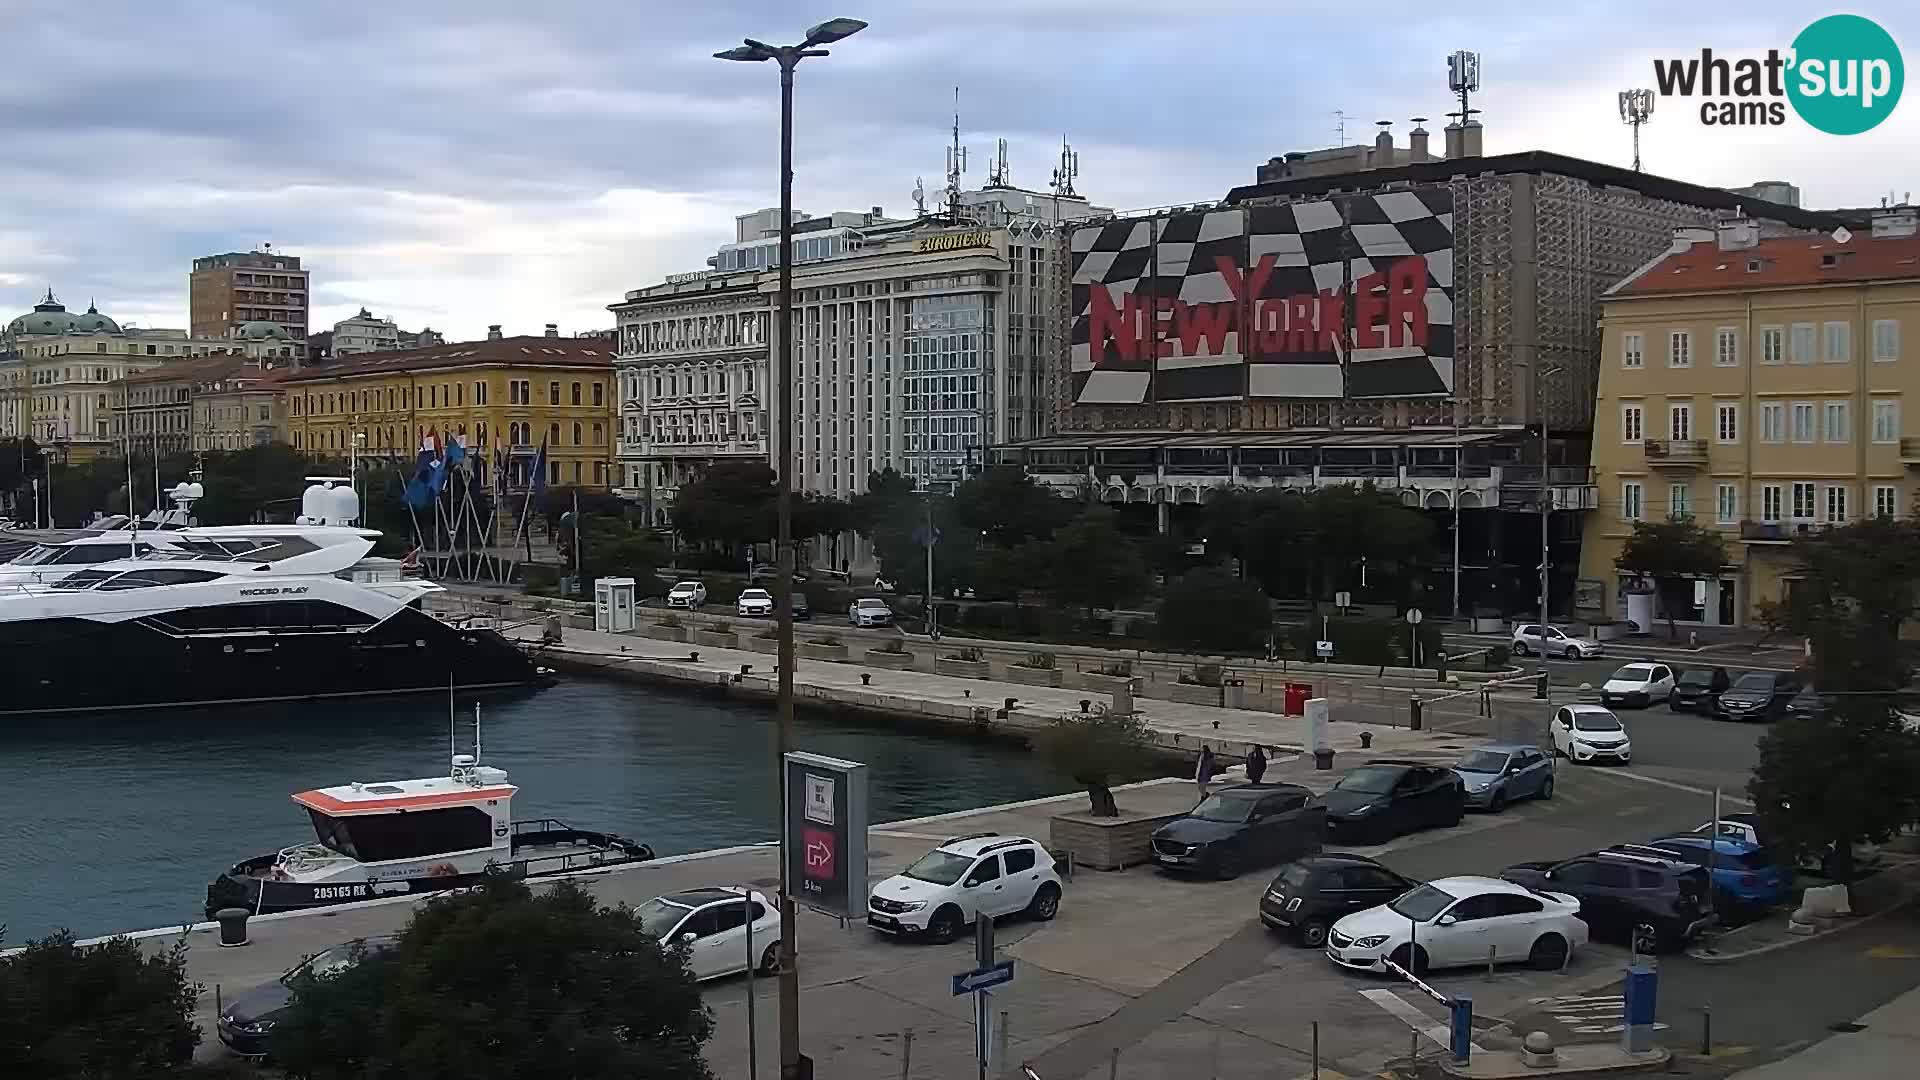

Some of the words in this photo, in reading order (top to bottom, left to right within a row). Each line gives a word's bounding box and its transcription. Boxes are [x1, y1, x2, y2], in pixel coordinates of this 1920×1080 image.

[1090, 279, 1229, 363] NEW
[1215, 255, 1428, 361] YORKER
[811, 881, 822, 892] km
